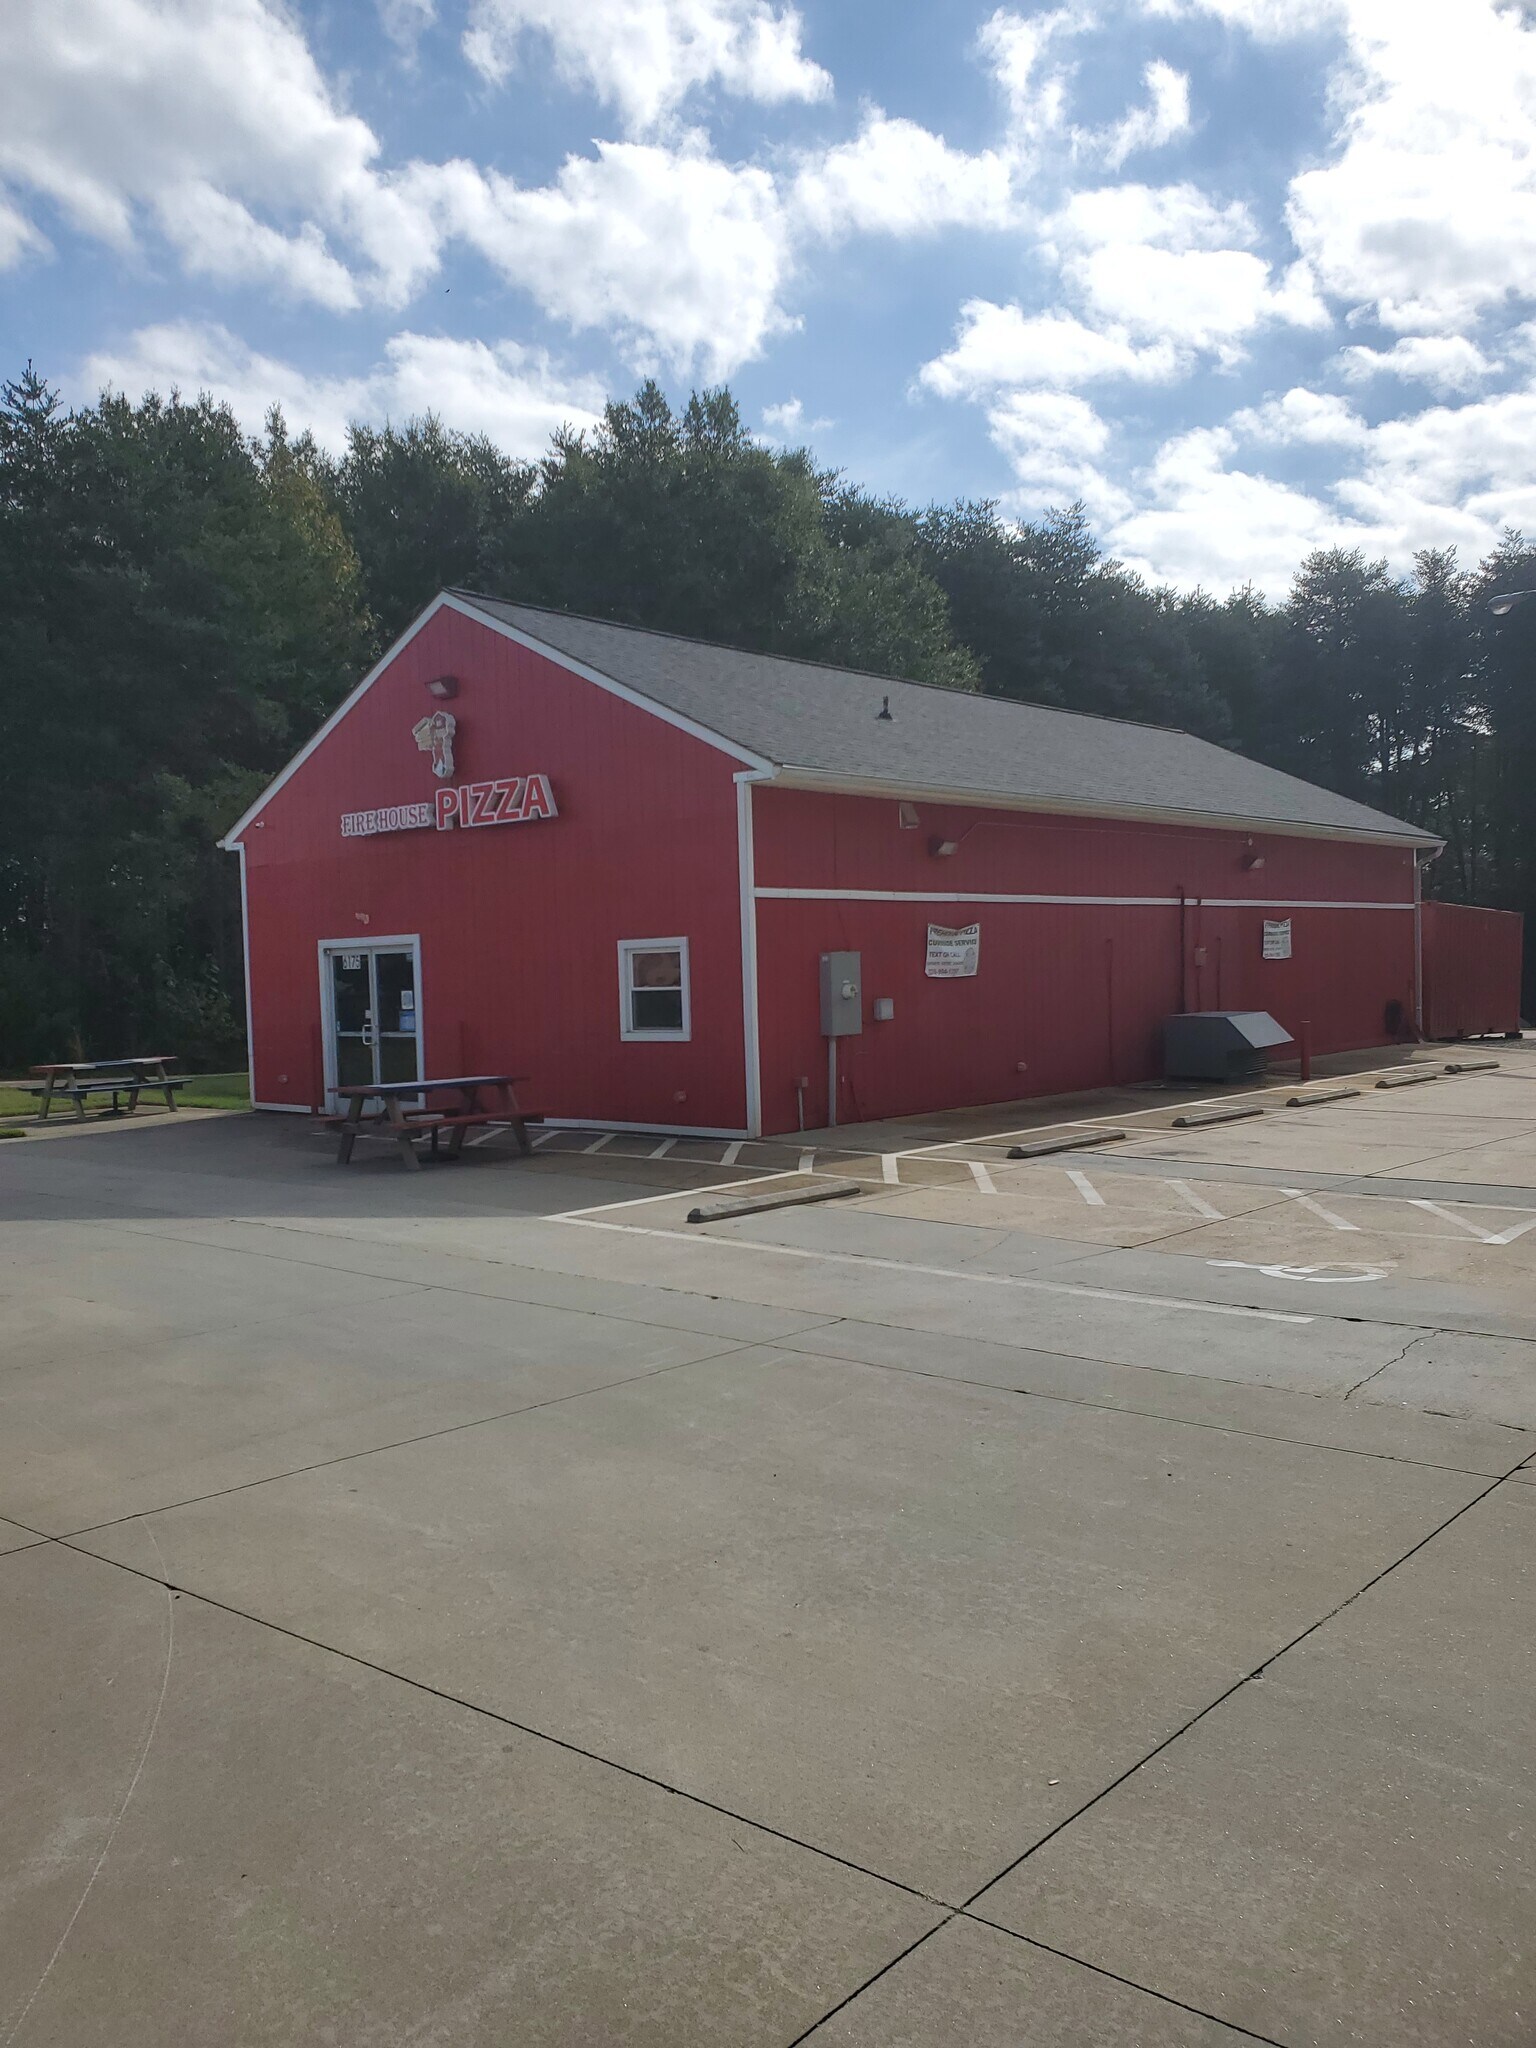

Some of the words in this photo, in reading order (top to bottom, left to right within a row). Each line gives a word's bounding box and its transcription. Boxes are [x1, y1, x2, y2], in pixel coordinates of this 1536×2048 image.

[342, 812, 376, 836] FIRE
[378, 804, 430, 830] HOUSE
[436, 774, 552, 831] PIZZA
[343, 954, 360, 969] 6175
